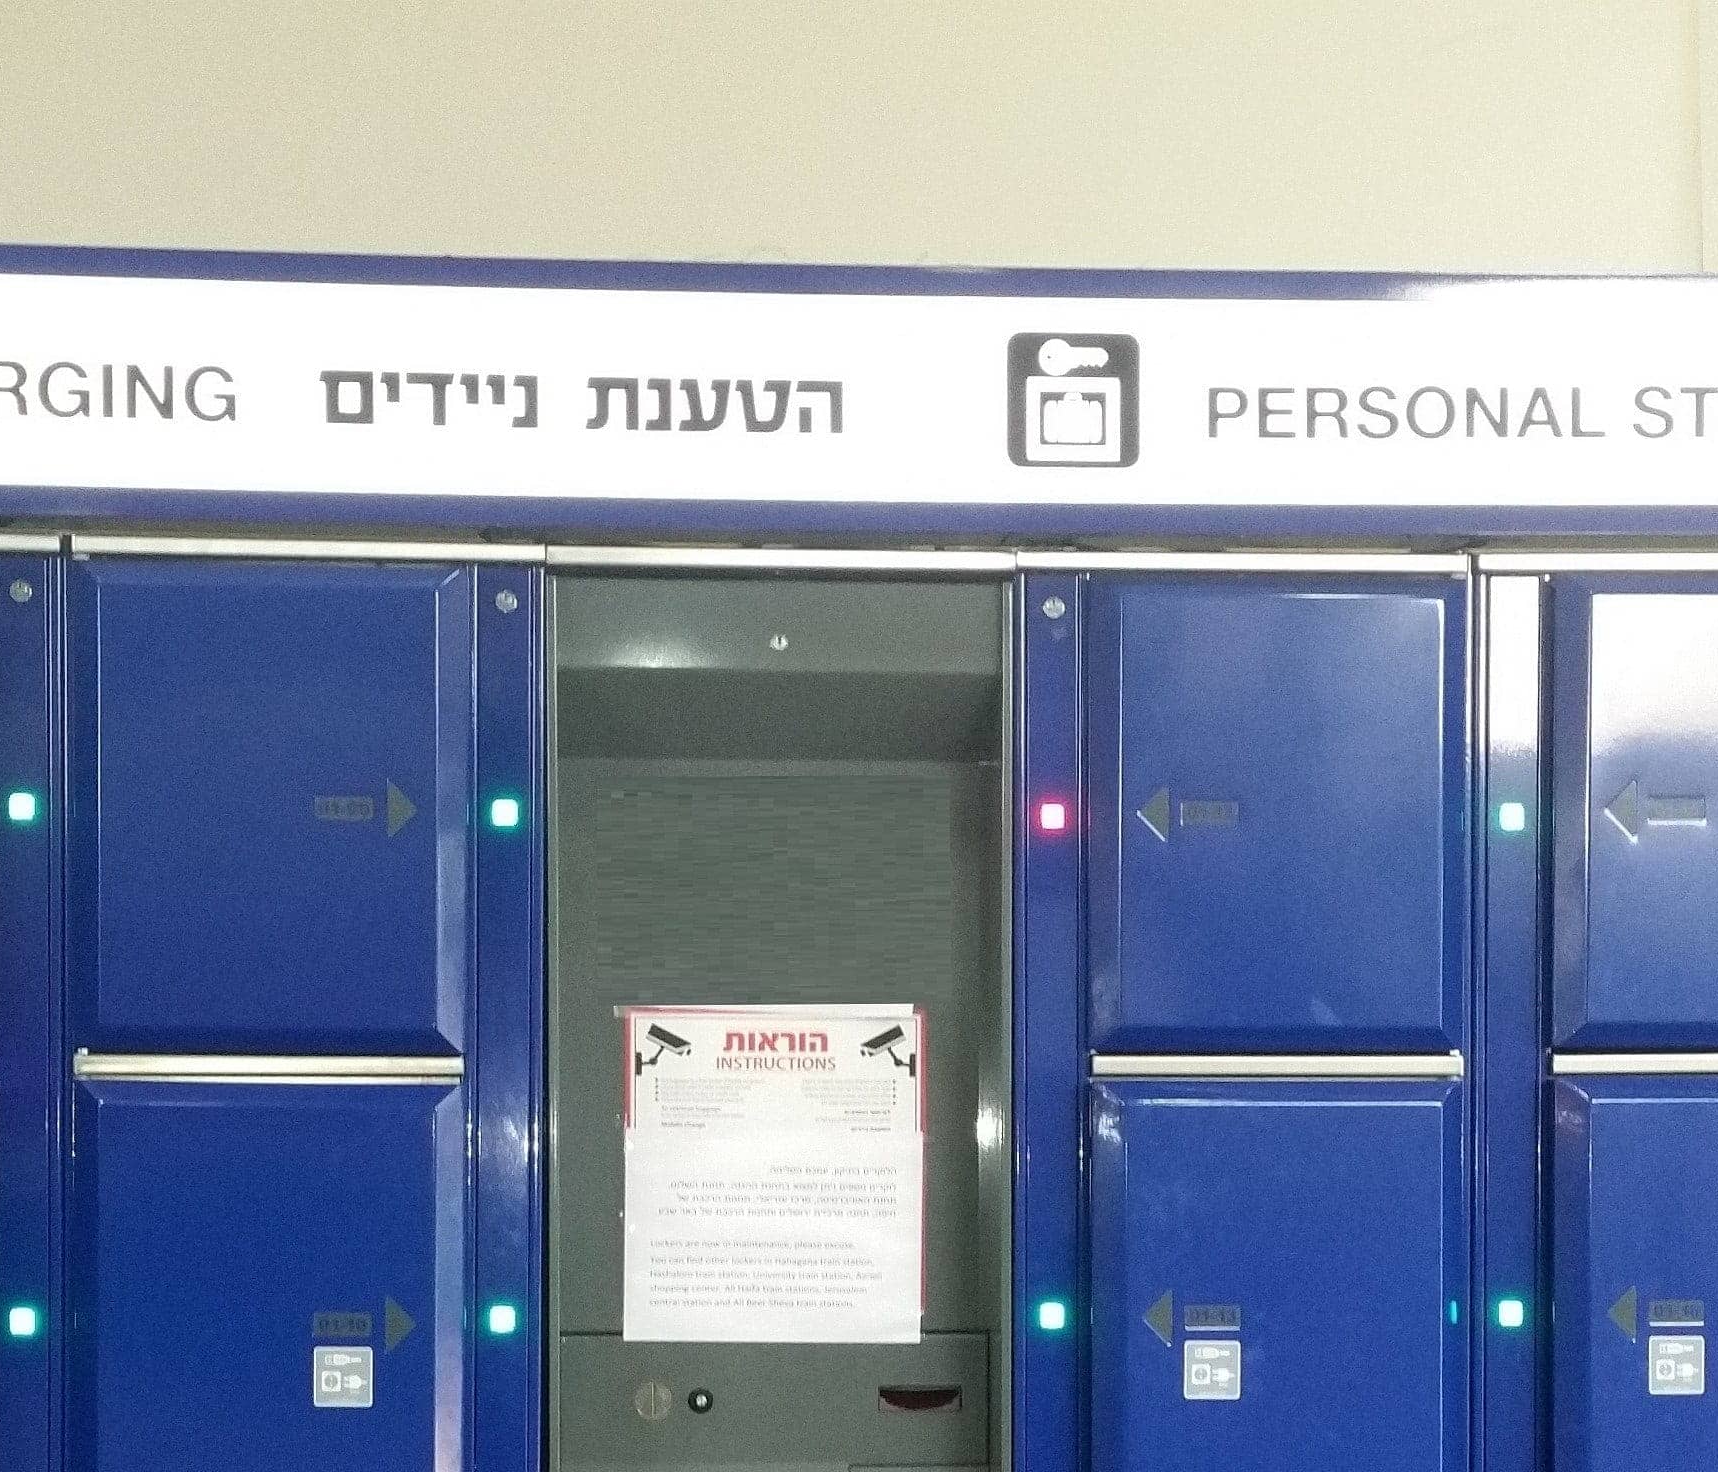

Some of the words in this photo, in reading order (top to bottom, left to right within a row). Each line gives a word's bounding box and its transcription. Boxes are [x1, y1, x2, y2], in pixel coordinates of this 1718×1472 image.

[319, 370, 539, 429] ניידים
[585, 377, 844, 434] הטענת
[1207, 386, 1606, 440] PERSONAL
[716, 1056, 837, 1071] INSTRUCTIONS
[723, 1032, 829, 1053] הוראות
